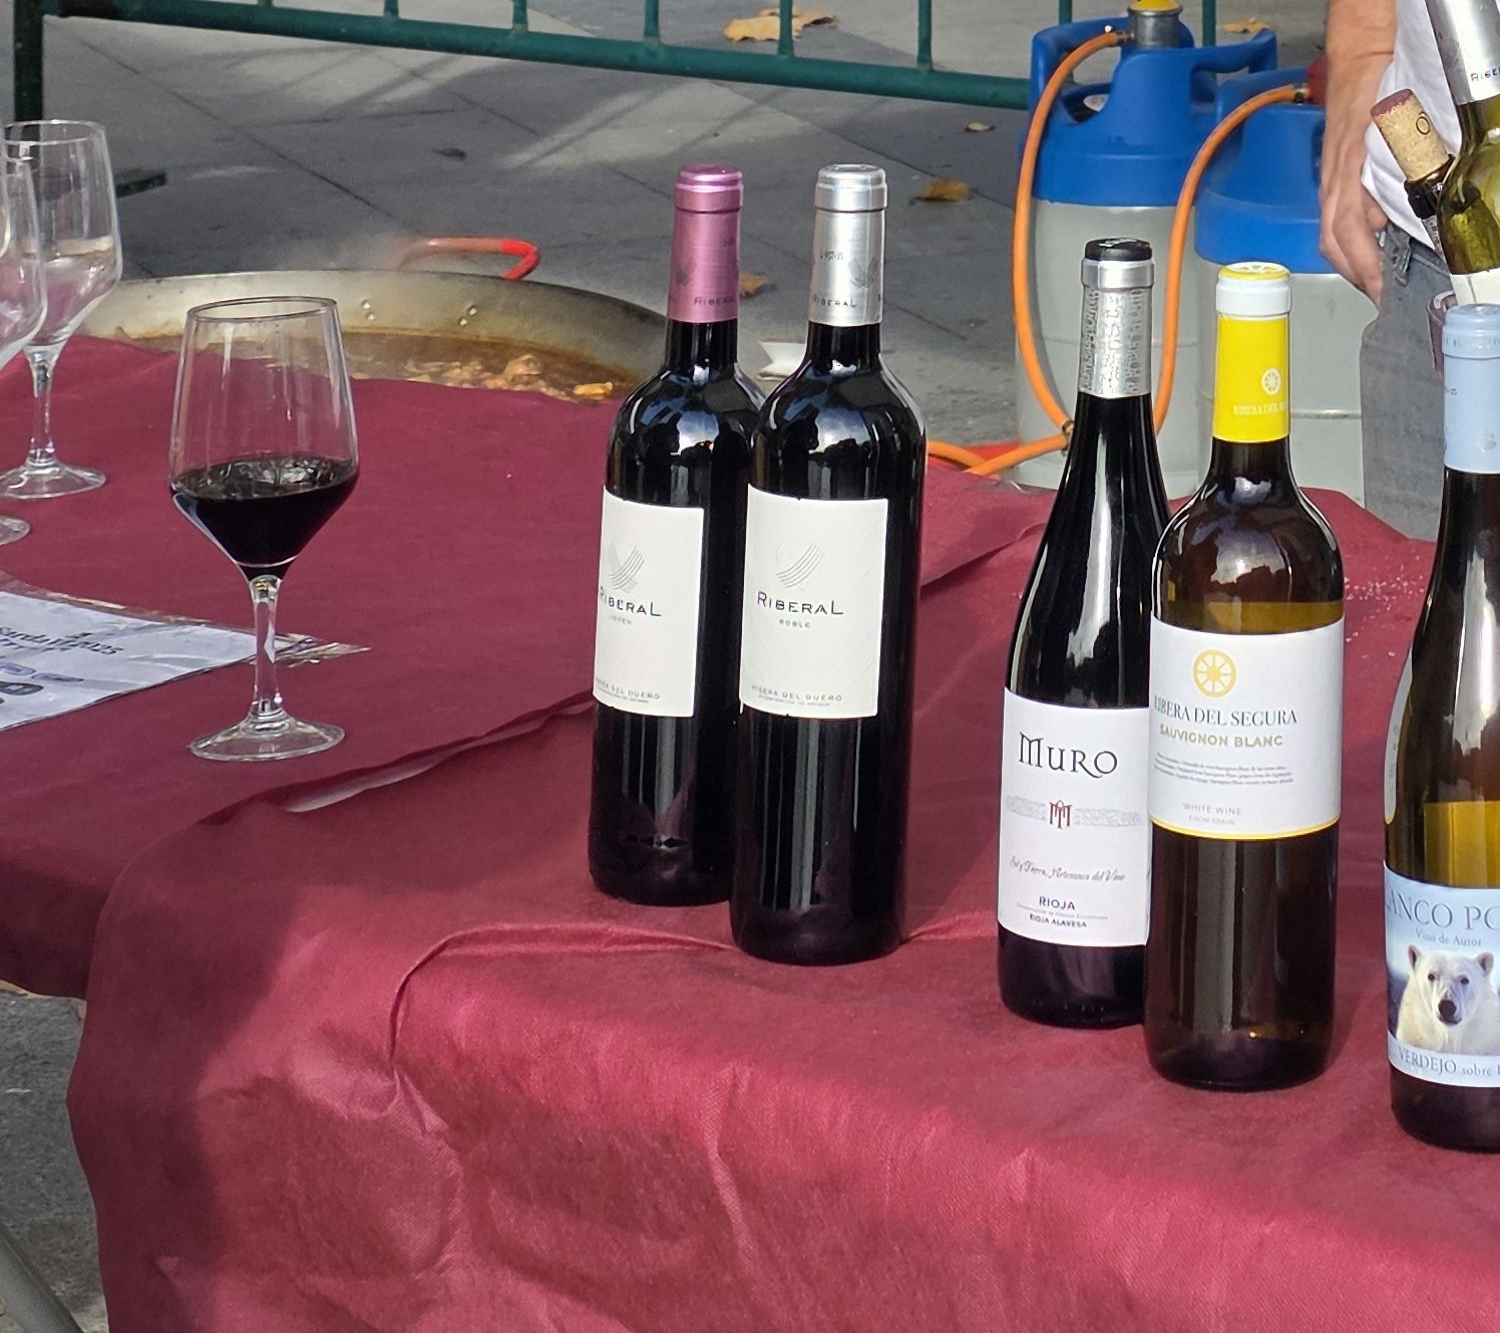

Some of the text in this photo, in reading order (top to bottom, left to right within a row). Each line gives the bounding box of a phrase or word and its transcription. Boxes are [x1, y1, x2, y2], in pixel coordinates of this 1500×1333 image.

[756, 590, 844, 615] RIBERAL
[804, 693, 843, 702] DUERO
[1194, 706, 1227, 726] DEL
[1231, 709, 1298, 727] SEGURA
[1160, 724, 1284, 748] SAUVIGNON BLANC
[1018, 731, 1118, 779] MURO
[1039, 896, 1076, 911] RIOJA
[1052, 915, 1088, 929] ALAVESA
[1415, 927, 1483, 947] Vino de Autor
[1398, 1045, 1458, 1076] VERDEJO
[1461, 1062, 1493, 1076] sobre
